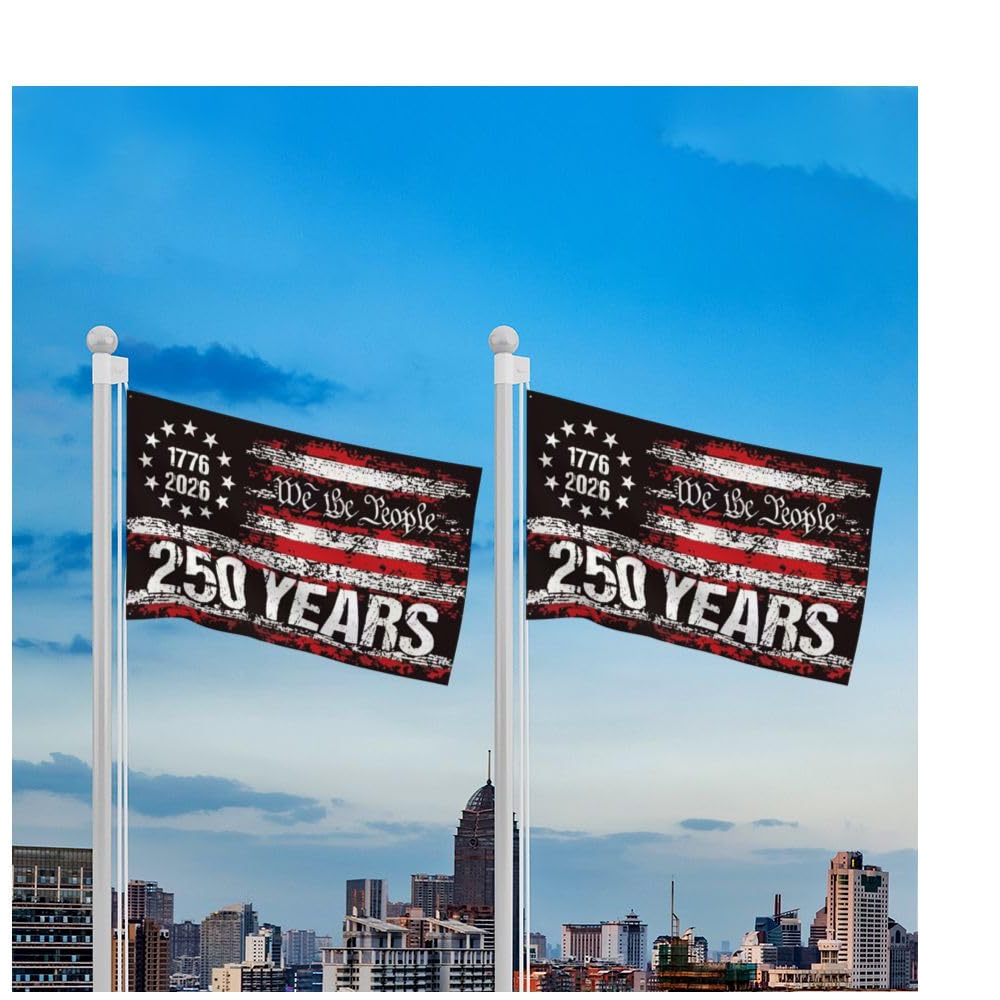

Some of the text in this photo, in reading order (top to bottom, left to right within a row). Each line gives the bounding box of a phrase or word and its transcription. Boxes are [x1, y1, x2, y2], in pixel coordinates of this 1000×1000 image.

[167, 446, 210, 475] 1776
[567, 446, 610, 475] 1776
[164, 472, 211, 501] 2026
[274, 475, 441, 538] We the People
[564, 472, 611, 501] 2026
[674, 475, 841, 538] We the People
[147, 540, 439, 656] 250 YEARS
[547, 540, 839, 656] 250 YEARS
